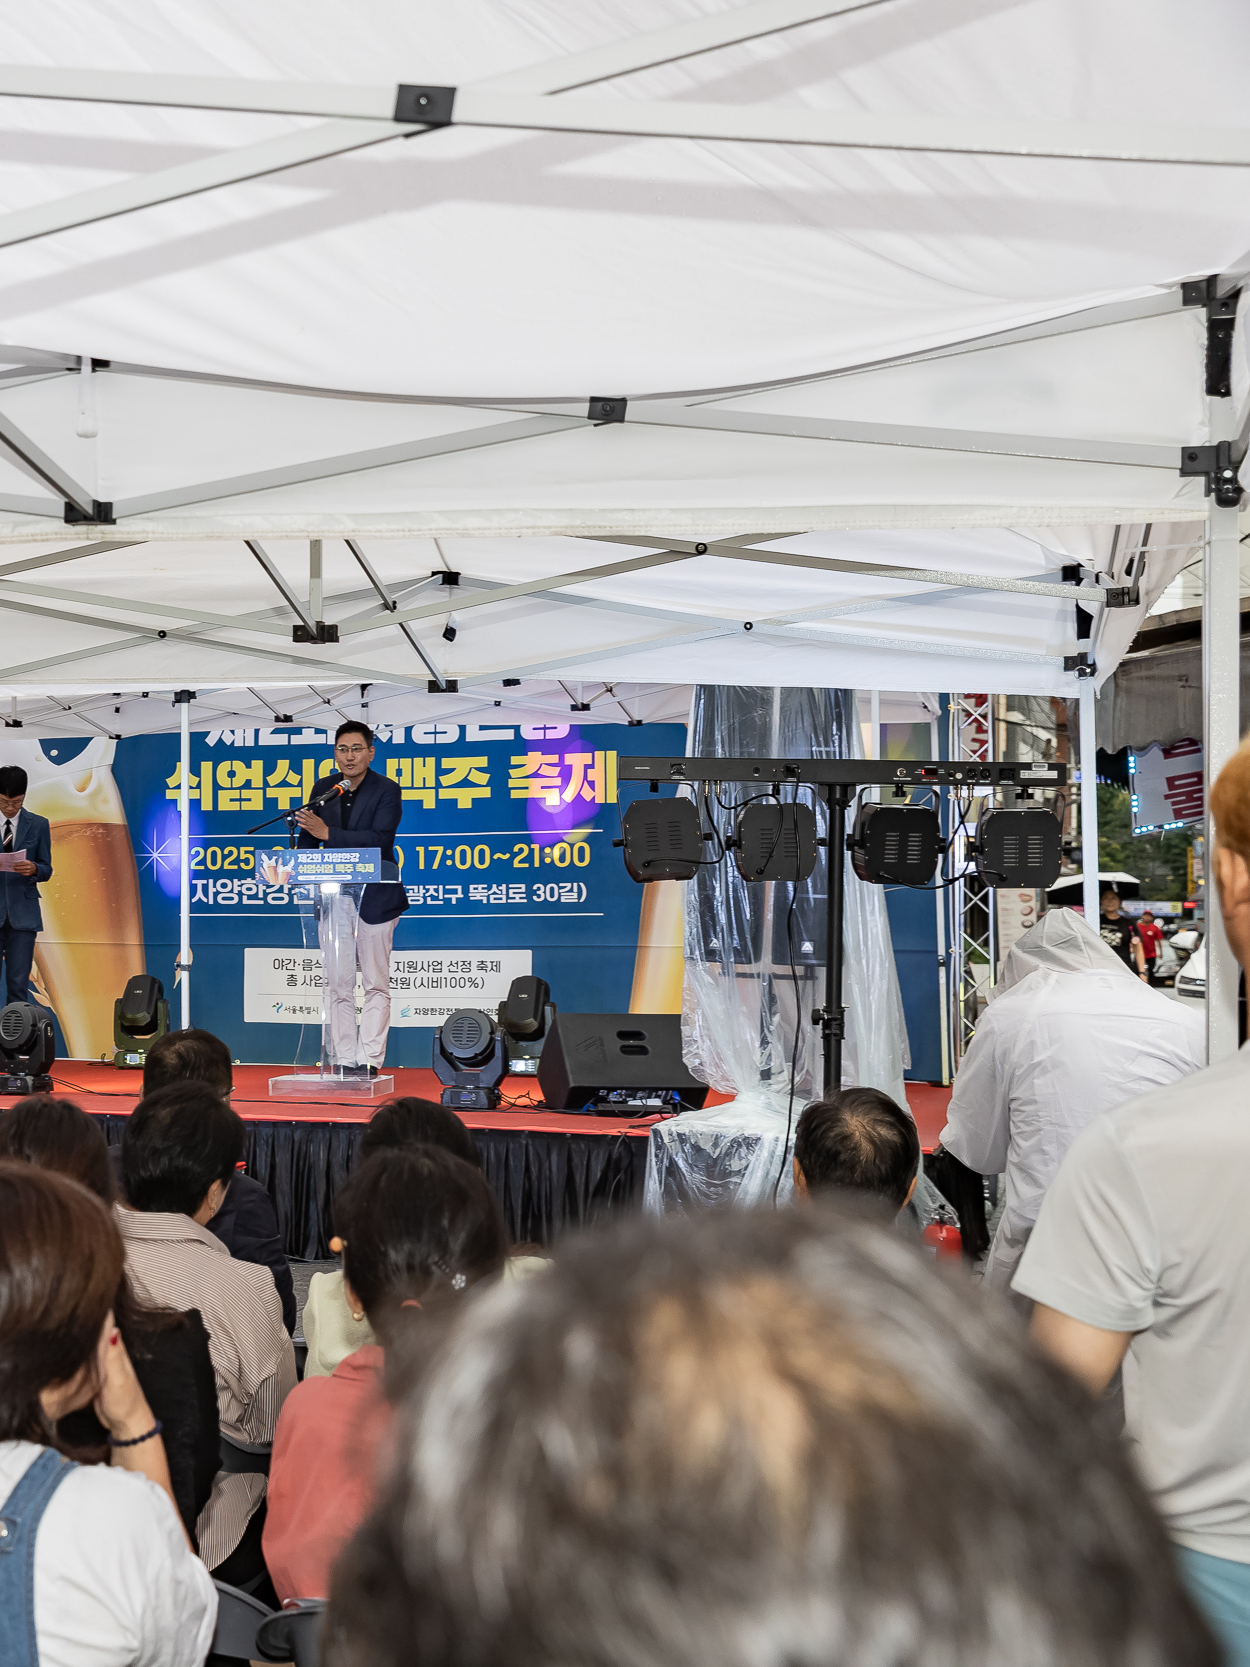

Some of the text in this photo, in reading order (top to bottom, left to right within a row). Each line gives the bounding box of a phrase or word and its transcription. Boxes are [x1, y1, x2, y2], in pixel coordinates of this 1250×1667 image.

[165, 750, 618, 811] 쉬엄쉬 맥주 축제
[190, 846, 255, 870] 2025
[415, 841, 591, 870] 17:00~21:00
[297, 864, 334, 874] 쉬엄쉬엄
[468, 884, 528, 904] 뚝섬로
[532, 882, 588, 903] 30길)
[393, 960, 443, 974] 지원사업
[446, 960, 472, 974] 선정
[475, 960, 502, 974] 축제
[286, 974, 298, 987] 총
[283, 1005, 319, 1015] 서울특별시
